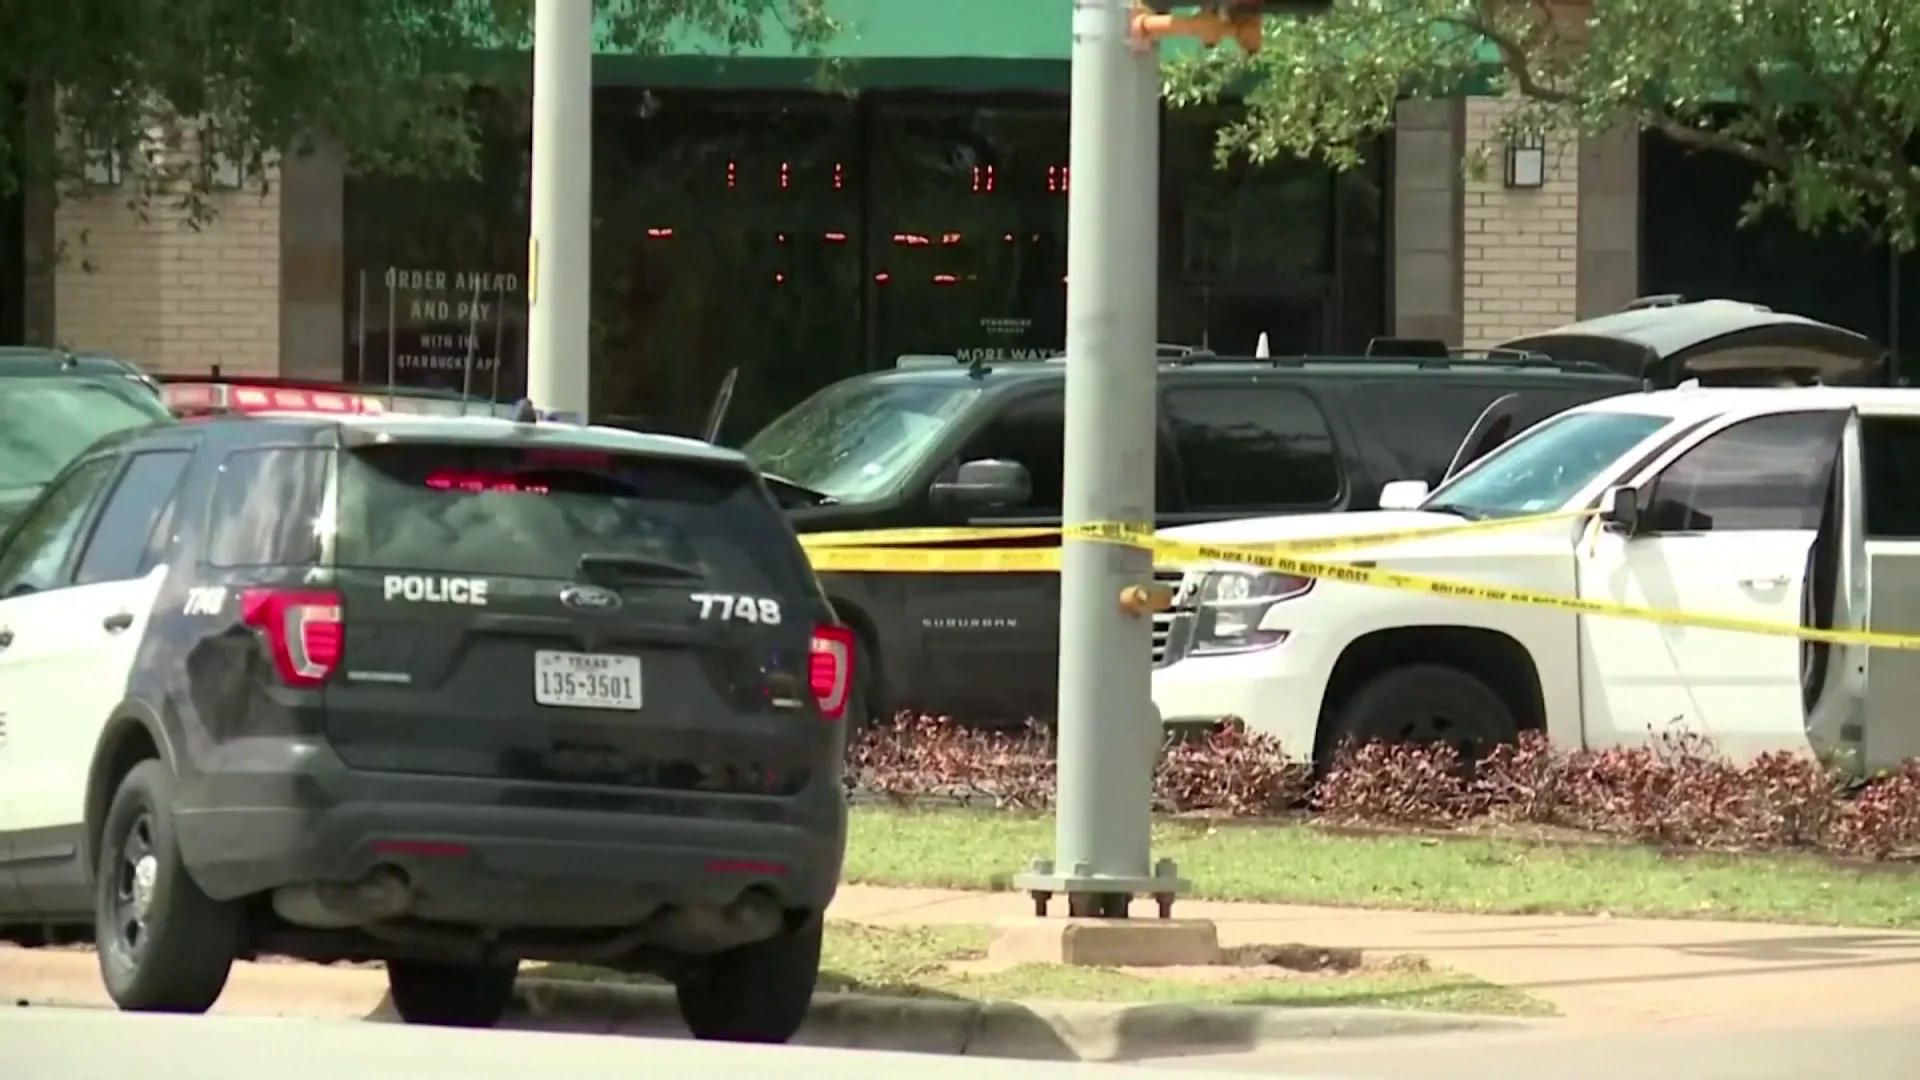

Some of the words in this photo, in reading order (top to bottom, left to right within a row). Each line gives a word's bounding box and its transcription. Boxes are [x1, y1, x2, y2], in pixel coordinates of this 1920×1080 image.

[385, 269, 446, 290] ORDER
[455, 272, 517, 291] AHEAD
[410, 301, 449, 320] AND
[458, 303, 491, 321] PAY
[957, 348, 1004, 360] MORE
[384, 575, 488, 605] POLICE
[689, 592, 782, 625] 7748
[922, 618, 1018, 628] SUBURBAN
[568, 656, 609, 669] TEXAS
[541, 671, 633, 699] 135-3501
